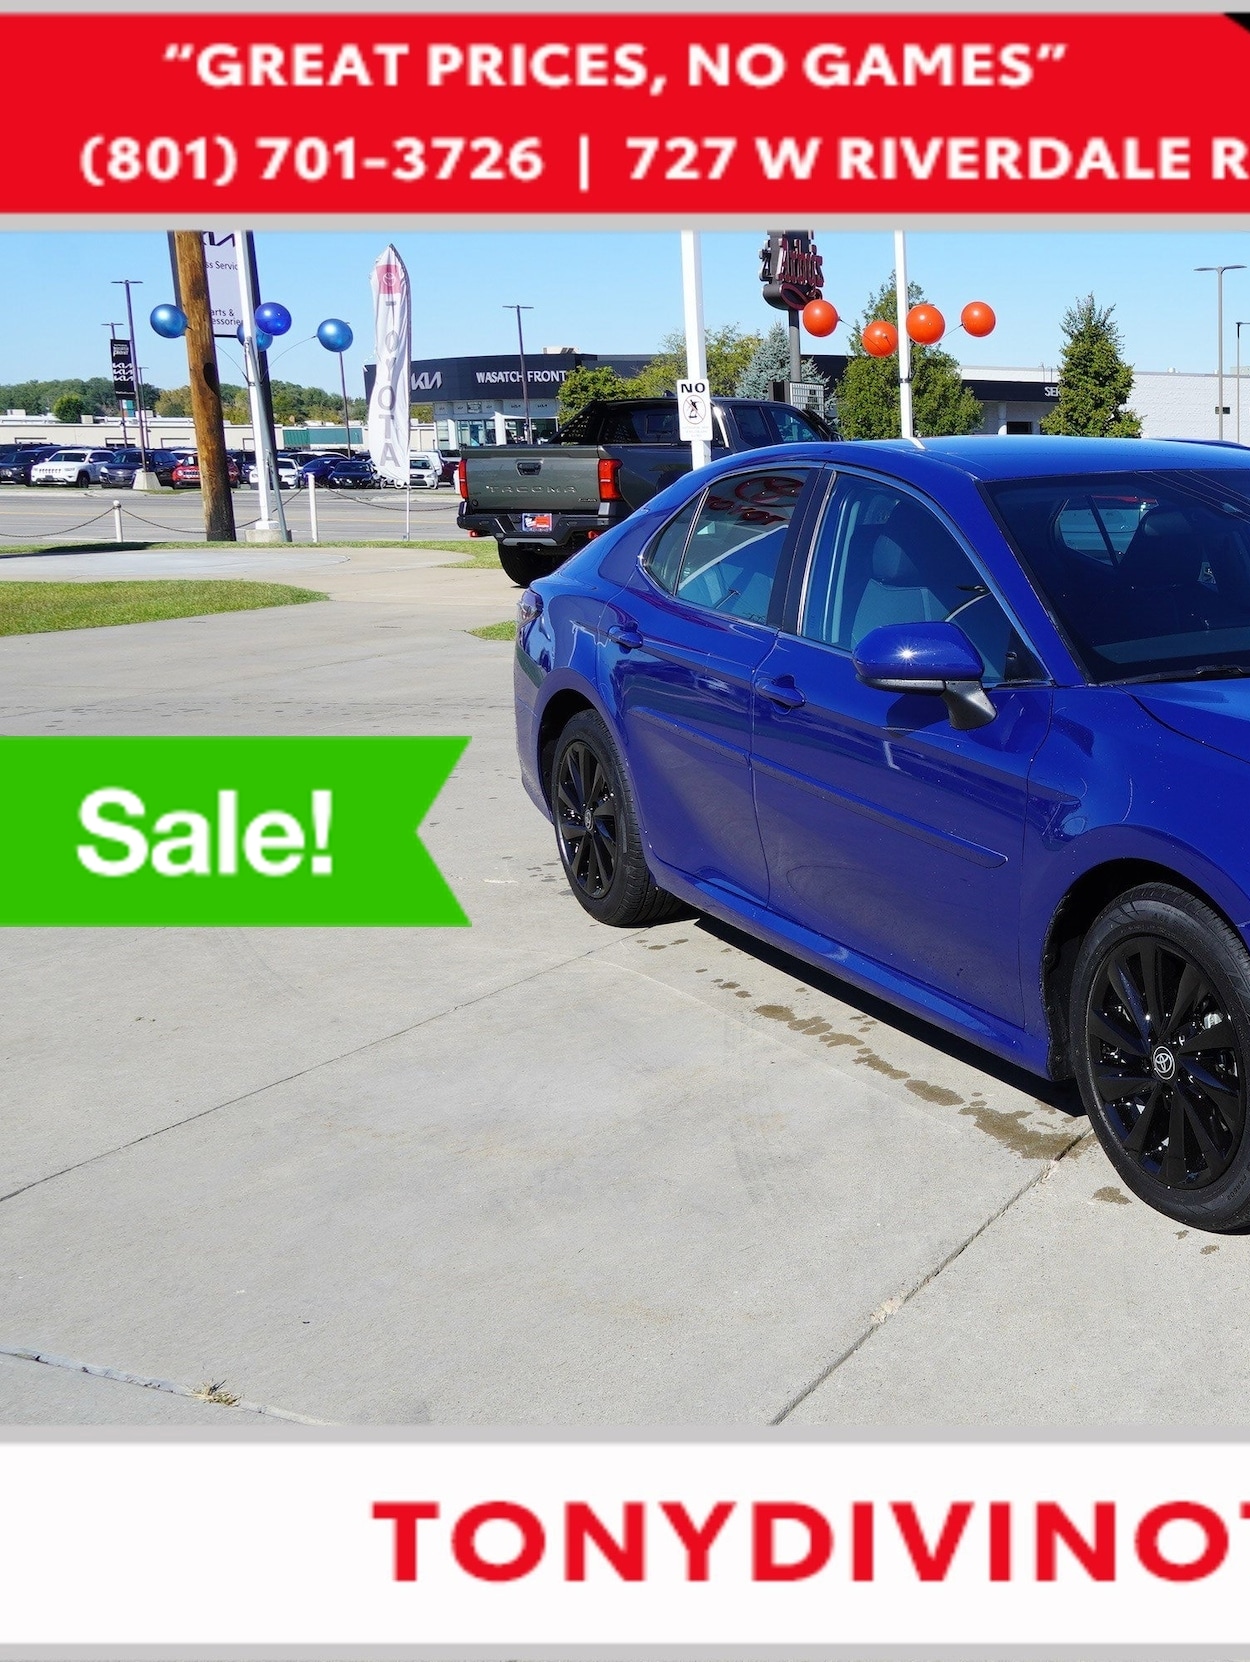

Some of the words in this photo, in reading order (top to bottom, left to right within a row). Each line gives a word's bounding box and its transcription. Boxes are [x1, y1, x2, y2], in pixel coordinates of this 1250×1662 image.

[216, 260, 239, 271] Servic
[211, 309, 227, 317] arts
[476, 371, 524, 384] WASATCH
[527, 370, 568, 383] FRONT
[681, 382, 706, 394] NO
[485, 485, 577, 494] TACOMA
